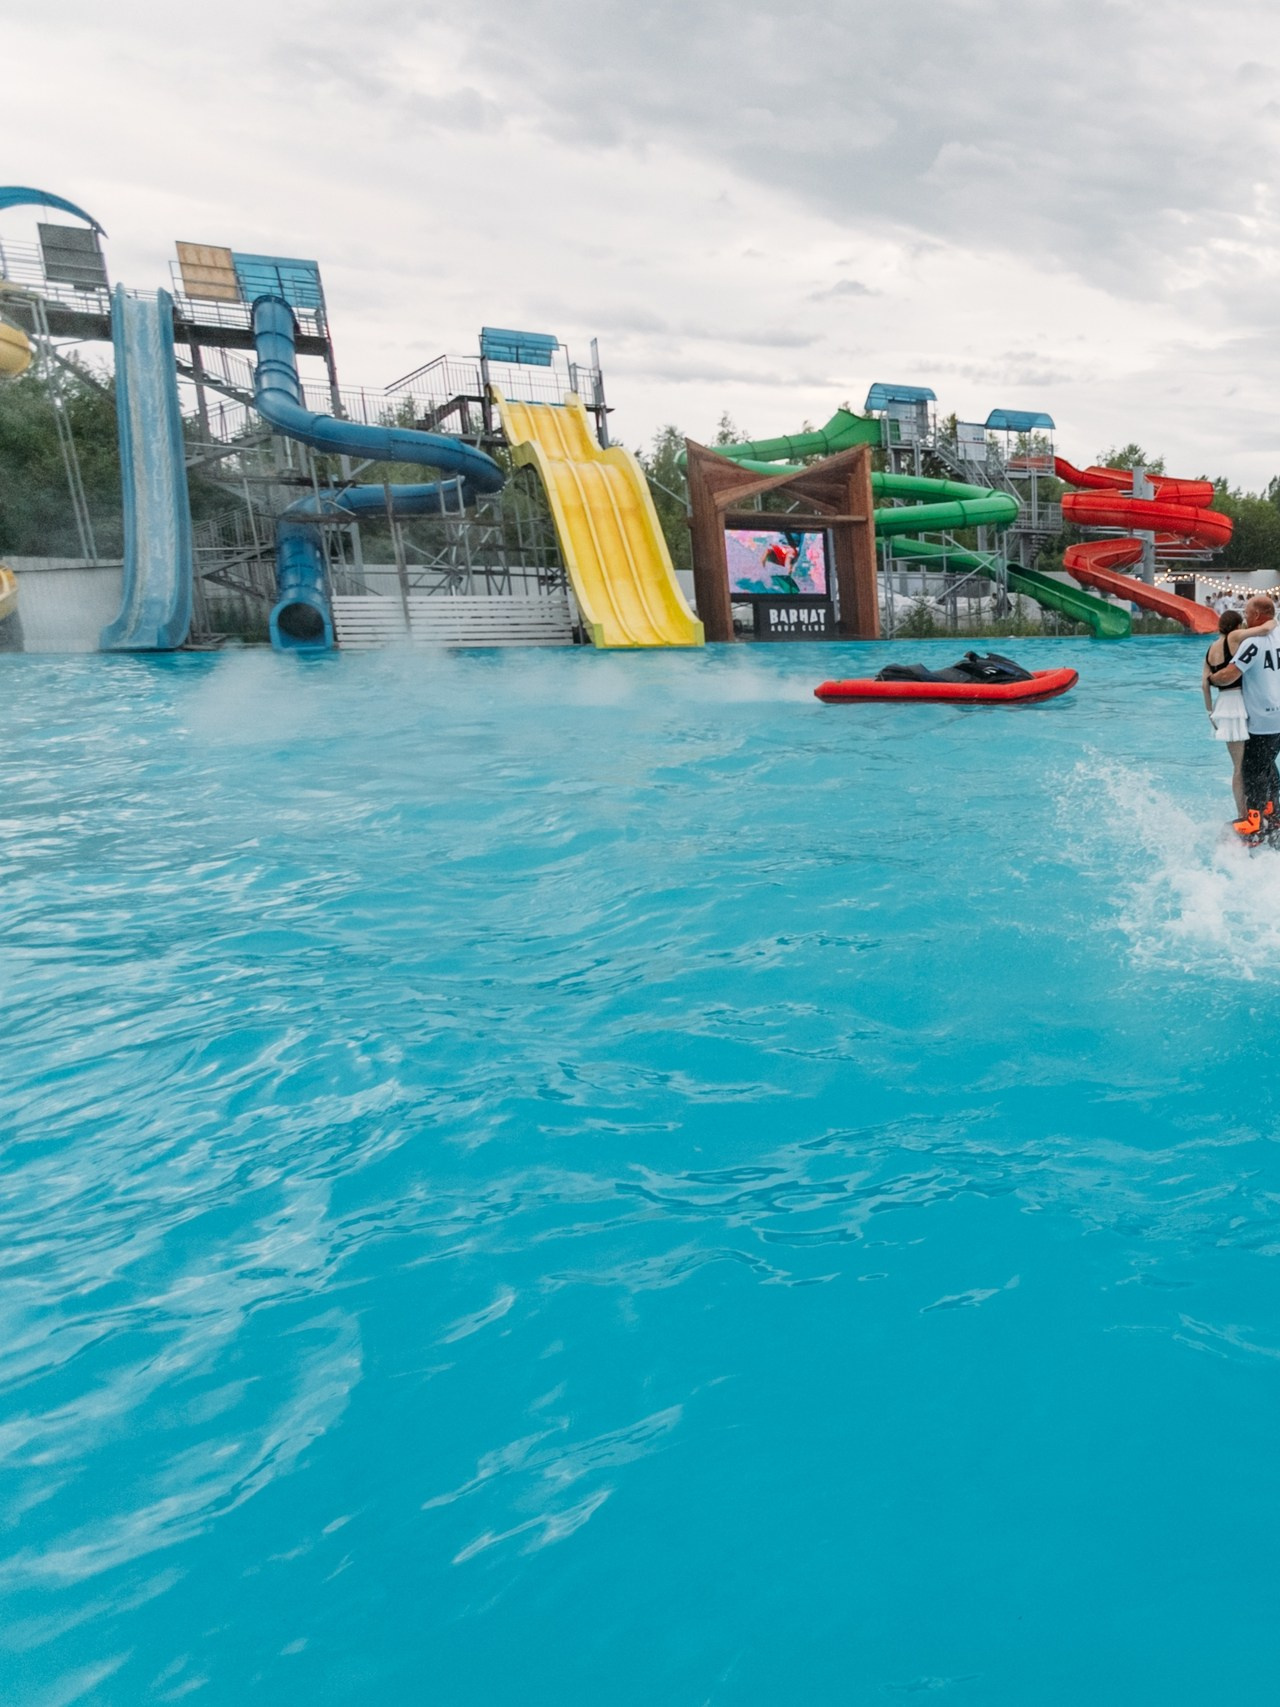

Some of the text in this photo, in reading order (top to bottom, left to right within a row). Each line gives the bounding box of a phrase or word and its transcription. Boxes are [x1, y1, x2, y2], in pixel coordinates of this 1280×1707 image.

[769, 608, 826, 624] BARHAT
[770, 624, 825, 632] AQUA CLUB
